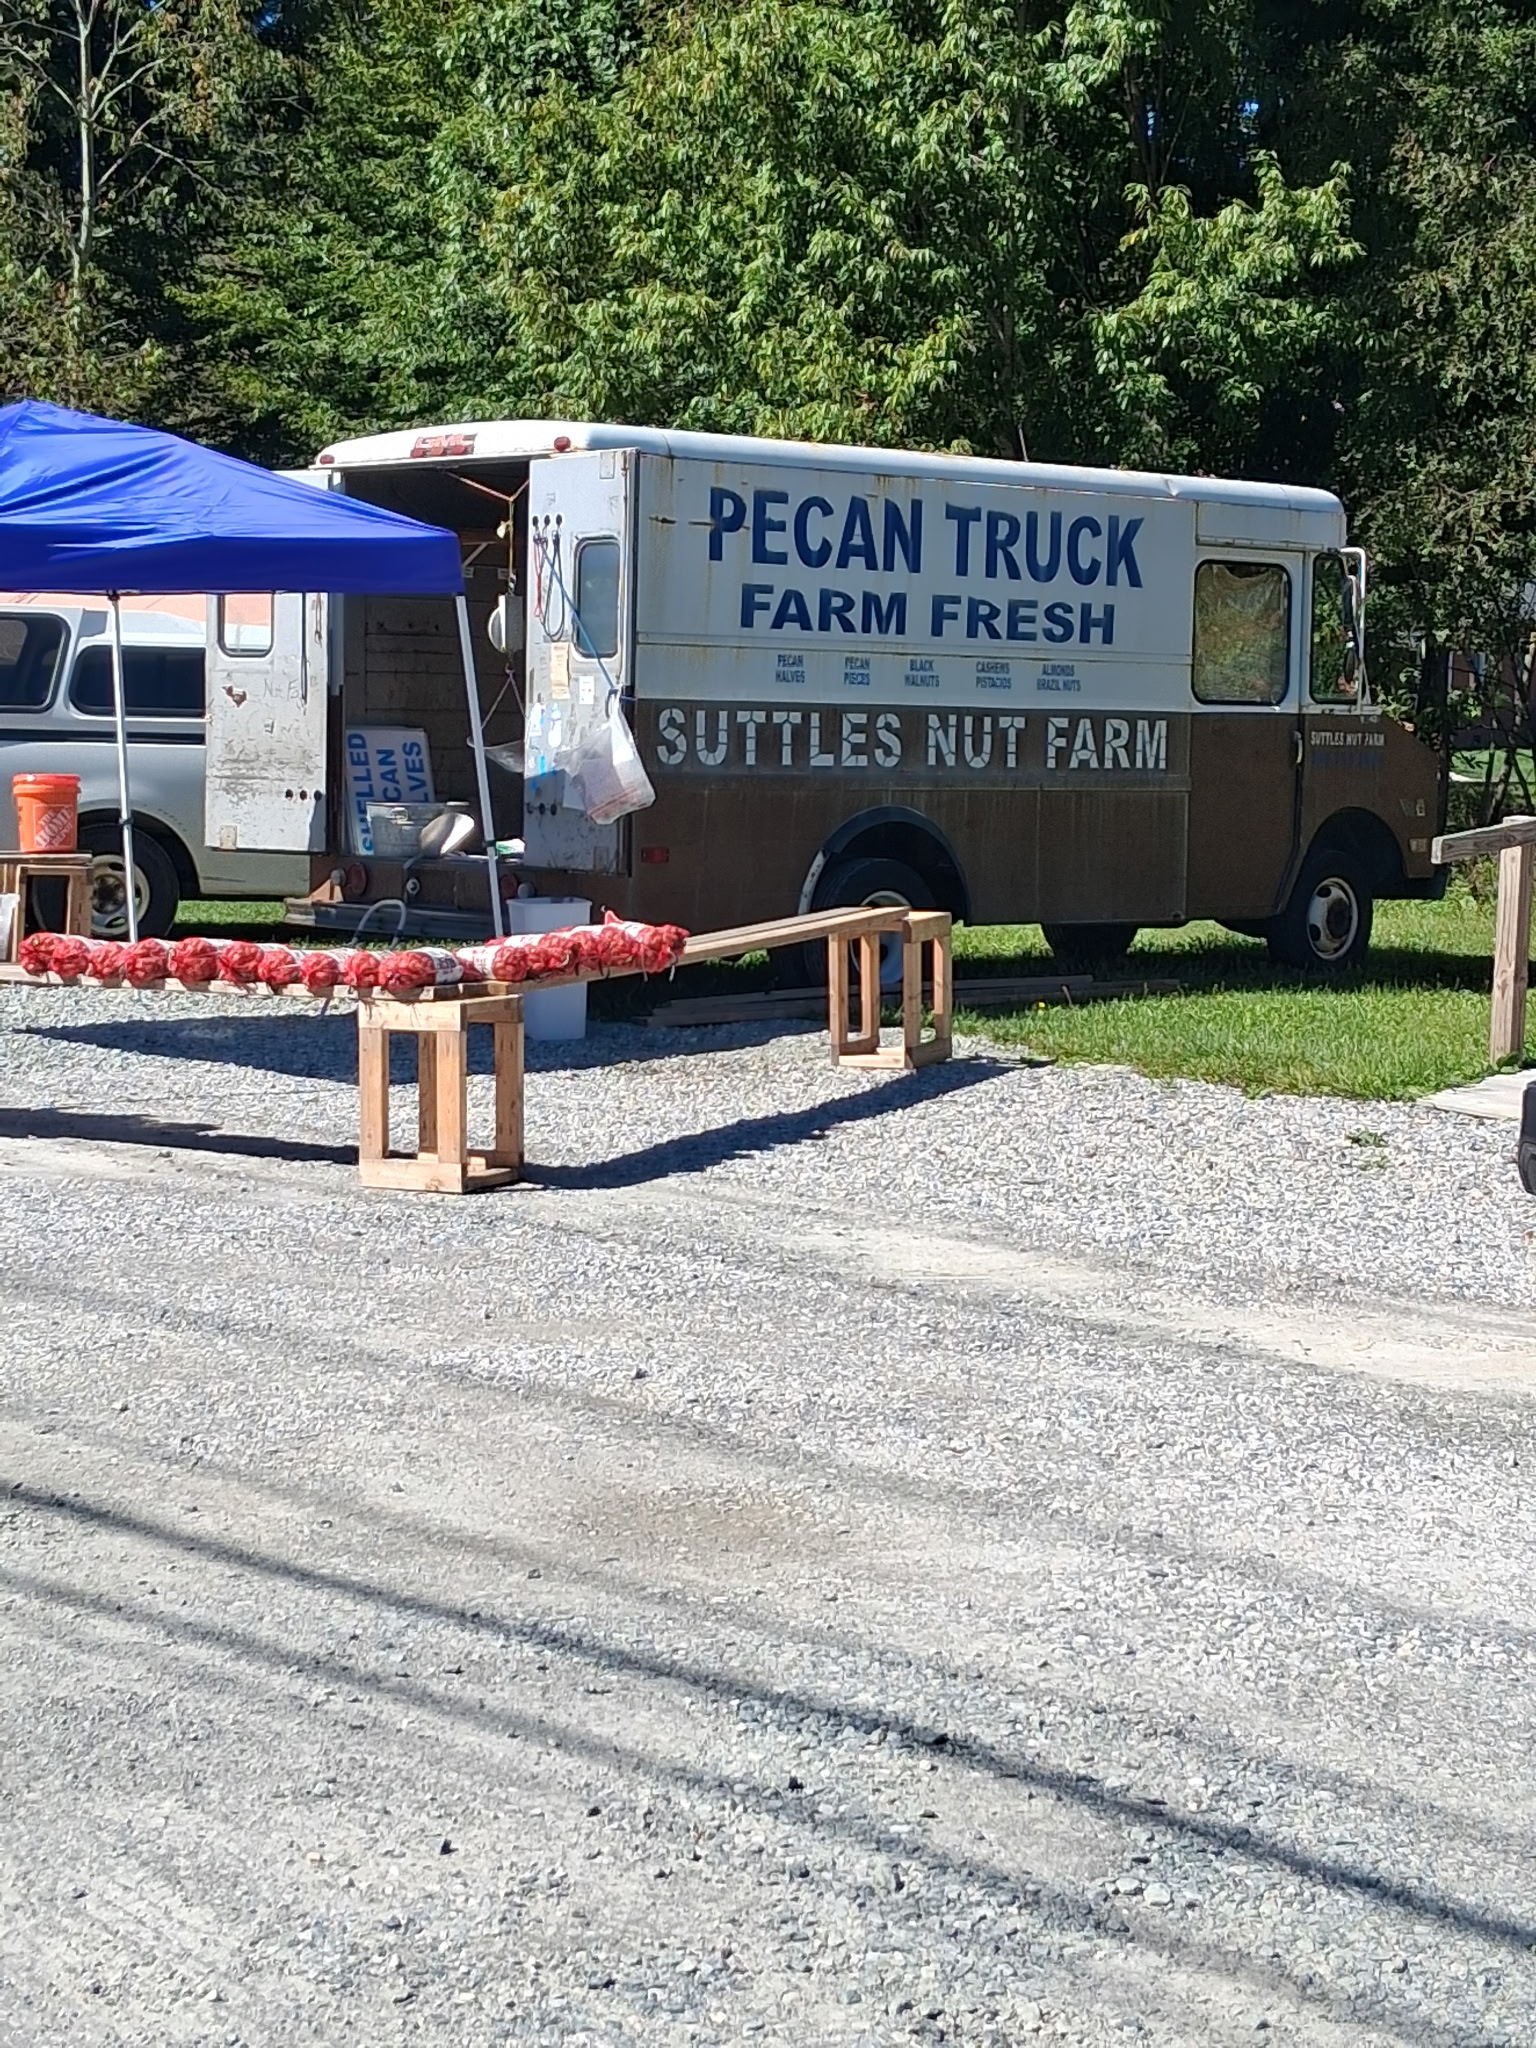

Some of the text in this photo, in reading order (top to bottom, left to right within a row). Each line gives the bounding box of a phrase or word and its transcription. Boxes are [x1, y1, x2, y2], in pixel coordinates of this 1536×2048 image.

[708, 486, 1145, 589] PECAN TRUCK
[740, 583, 1115, 645] FARM FRESH
[777, 653, 804, 668] PECAN
[844, 656, 871, 670] PECAN
[909, 658, 935, 672] BLACK
[775, 670, 805, 684] HALVES
[1041, 663, 1075, 677] ALMONDS
[904, 674, 940, 688] WALNUTS
[1062, 679, 1081, 693] NUTS
[656, 707, 1168, 770] SUTTLES NUT FARM
[1311, 731, 1385, 746] SUTTLES NUT FARM
[376, 749, 402, 801] CAN
[35, 807, 73, 847] HOME
